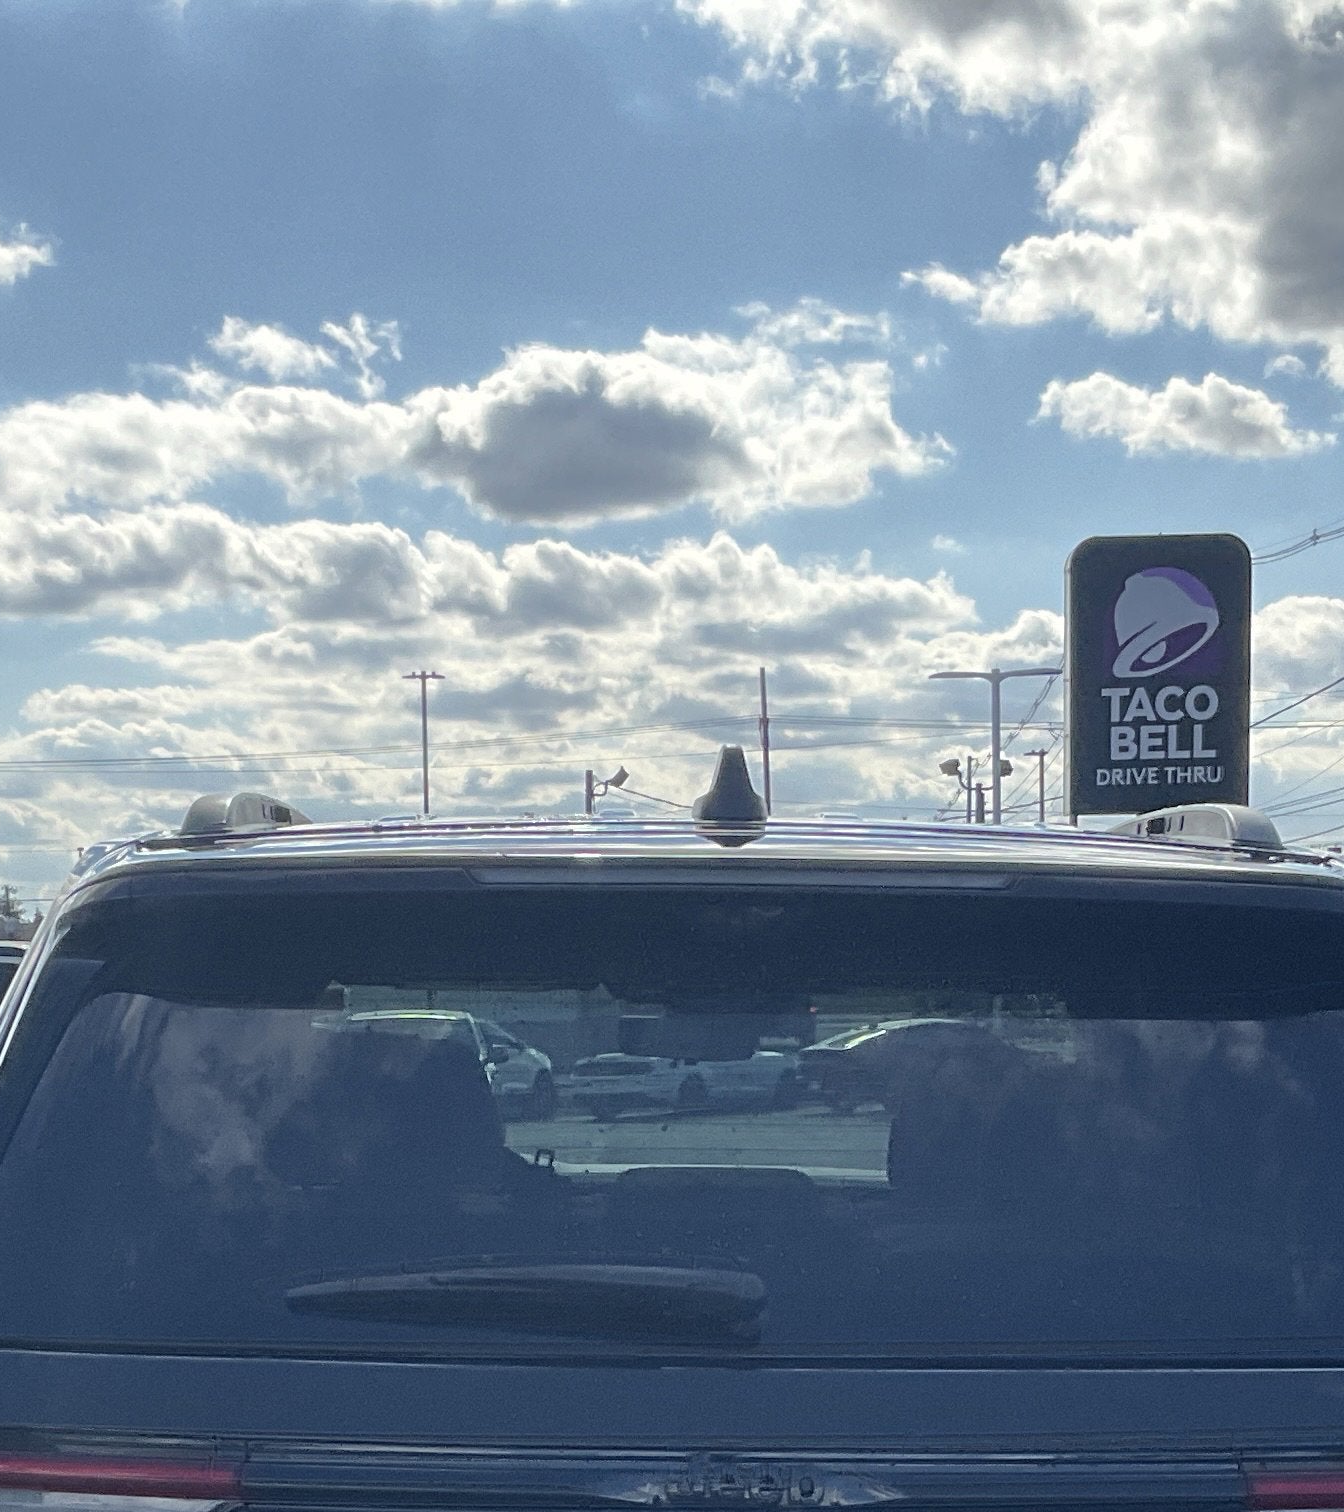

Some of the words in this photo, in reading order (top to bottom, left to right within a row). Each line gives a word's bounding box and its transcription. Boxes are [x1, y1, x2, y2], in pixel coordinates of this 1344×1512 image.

[1101, 684, 1219, 722] TACO
[1110, 724, 1217, 761] BELL
[1096, 765, 1159, 786] DRIVE
[1164, 764, 1224, 785] THRU
